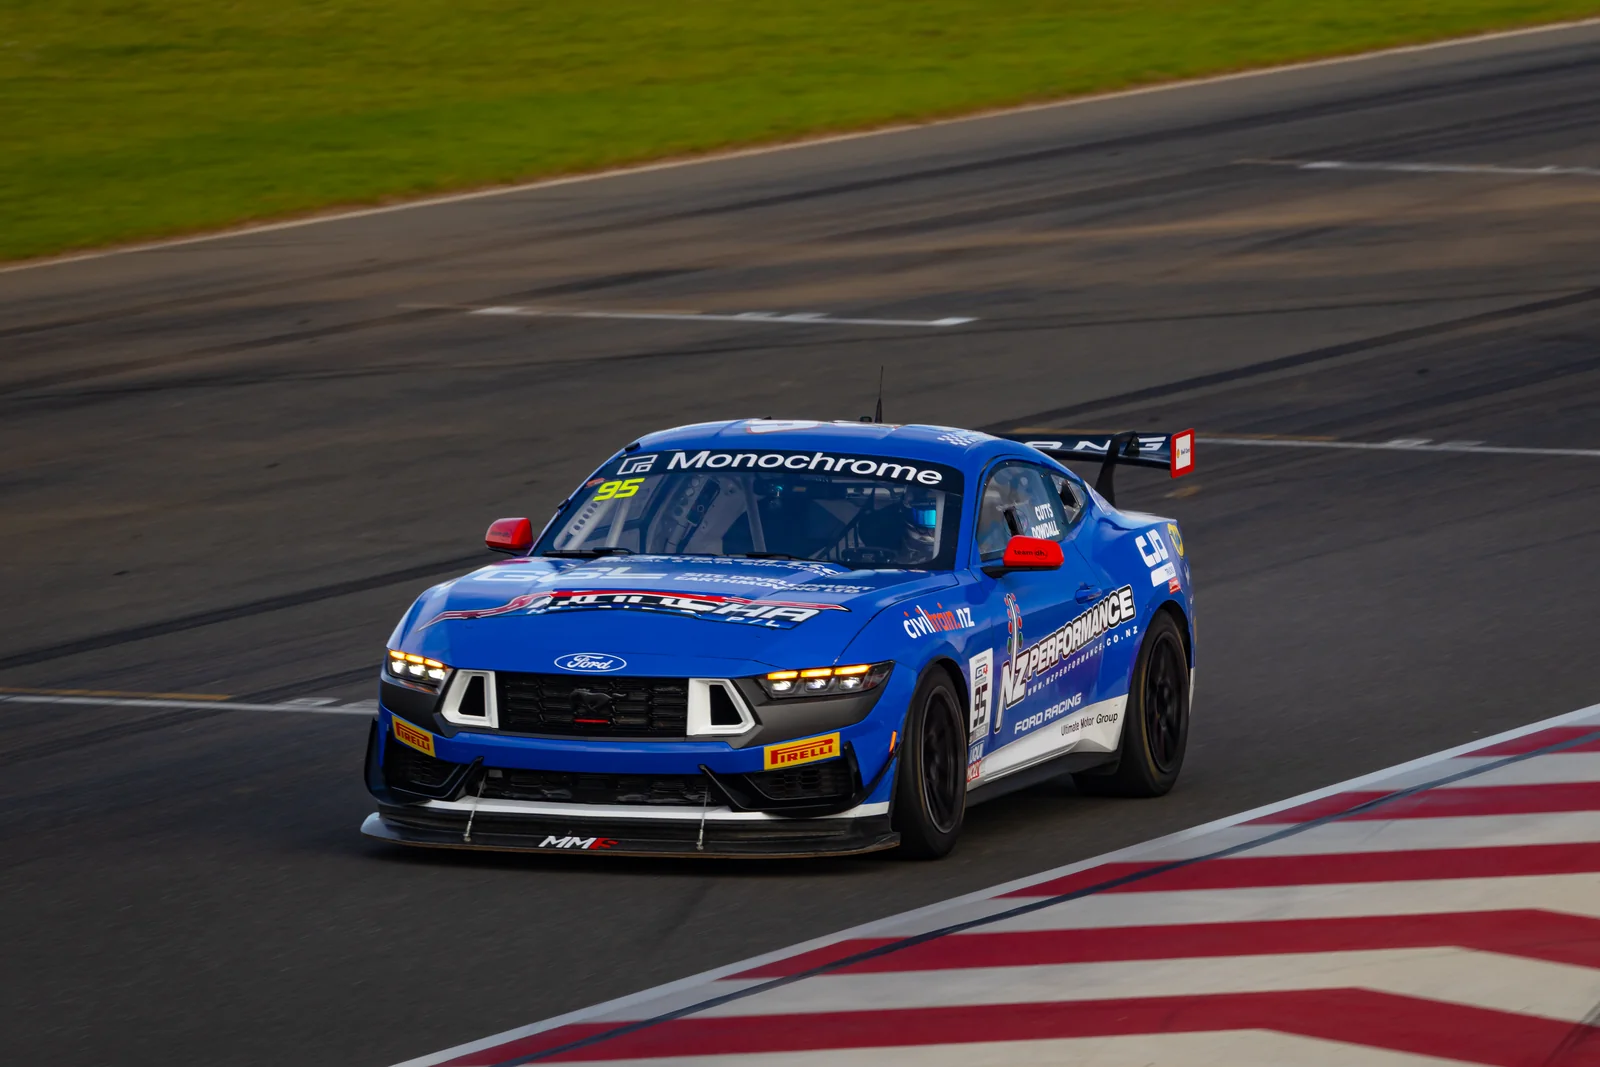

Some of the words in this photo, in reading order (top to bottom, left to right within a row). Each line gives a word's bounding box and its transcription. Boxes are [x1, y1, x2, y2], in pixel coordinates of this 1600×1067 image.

[667, 450, 943, 486] Monochrome
[592, 477, 646, 502] 95
[1034, 503, 1054, 521] CUTTS
[566, 654, 614, 670] Ford
[973, 683, 988, 728] 95
[1014, 711, 1043, 735] FORD
[1044, 692, 1083, 722] RACING
[395, 721, 431, 752] PIRELLI
[1060, 720, 1080, 737] Ultimate
[1080, 717, 1095, 729] Motor
[1096, 712, 1119, 724] Group
[770, 738, 834, 765] PIRELLI
